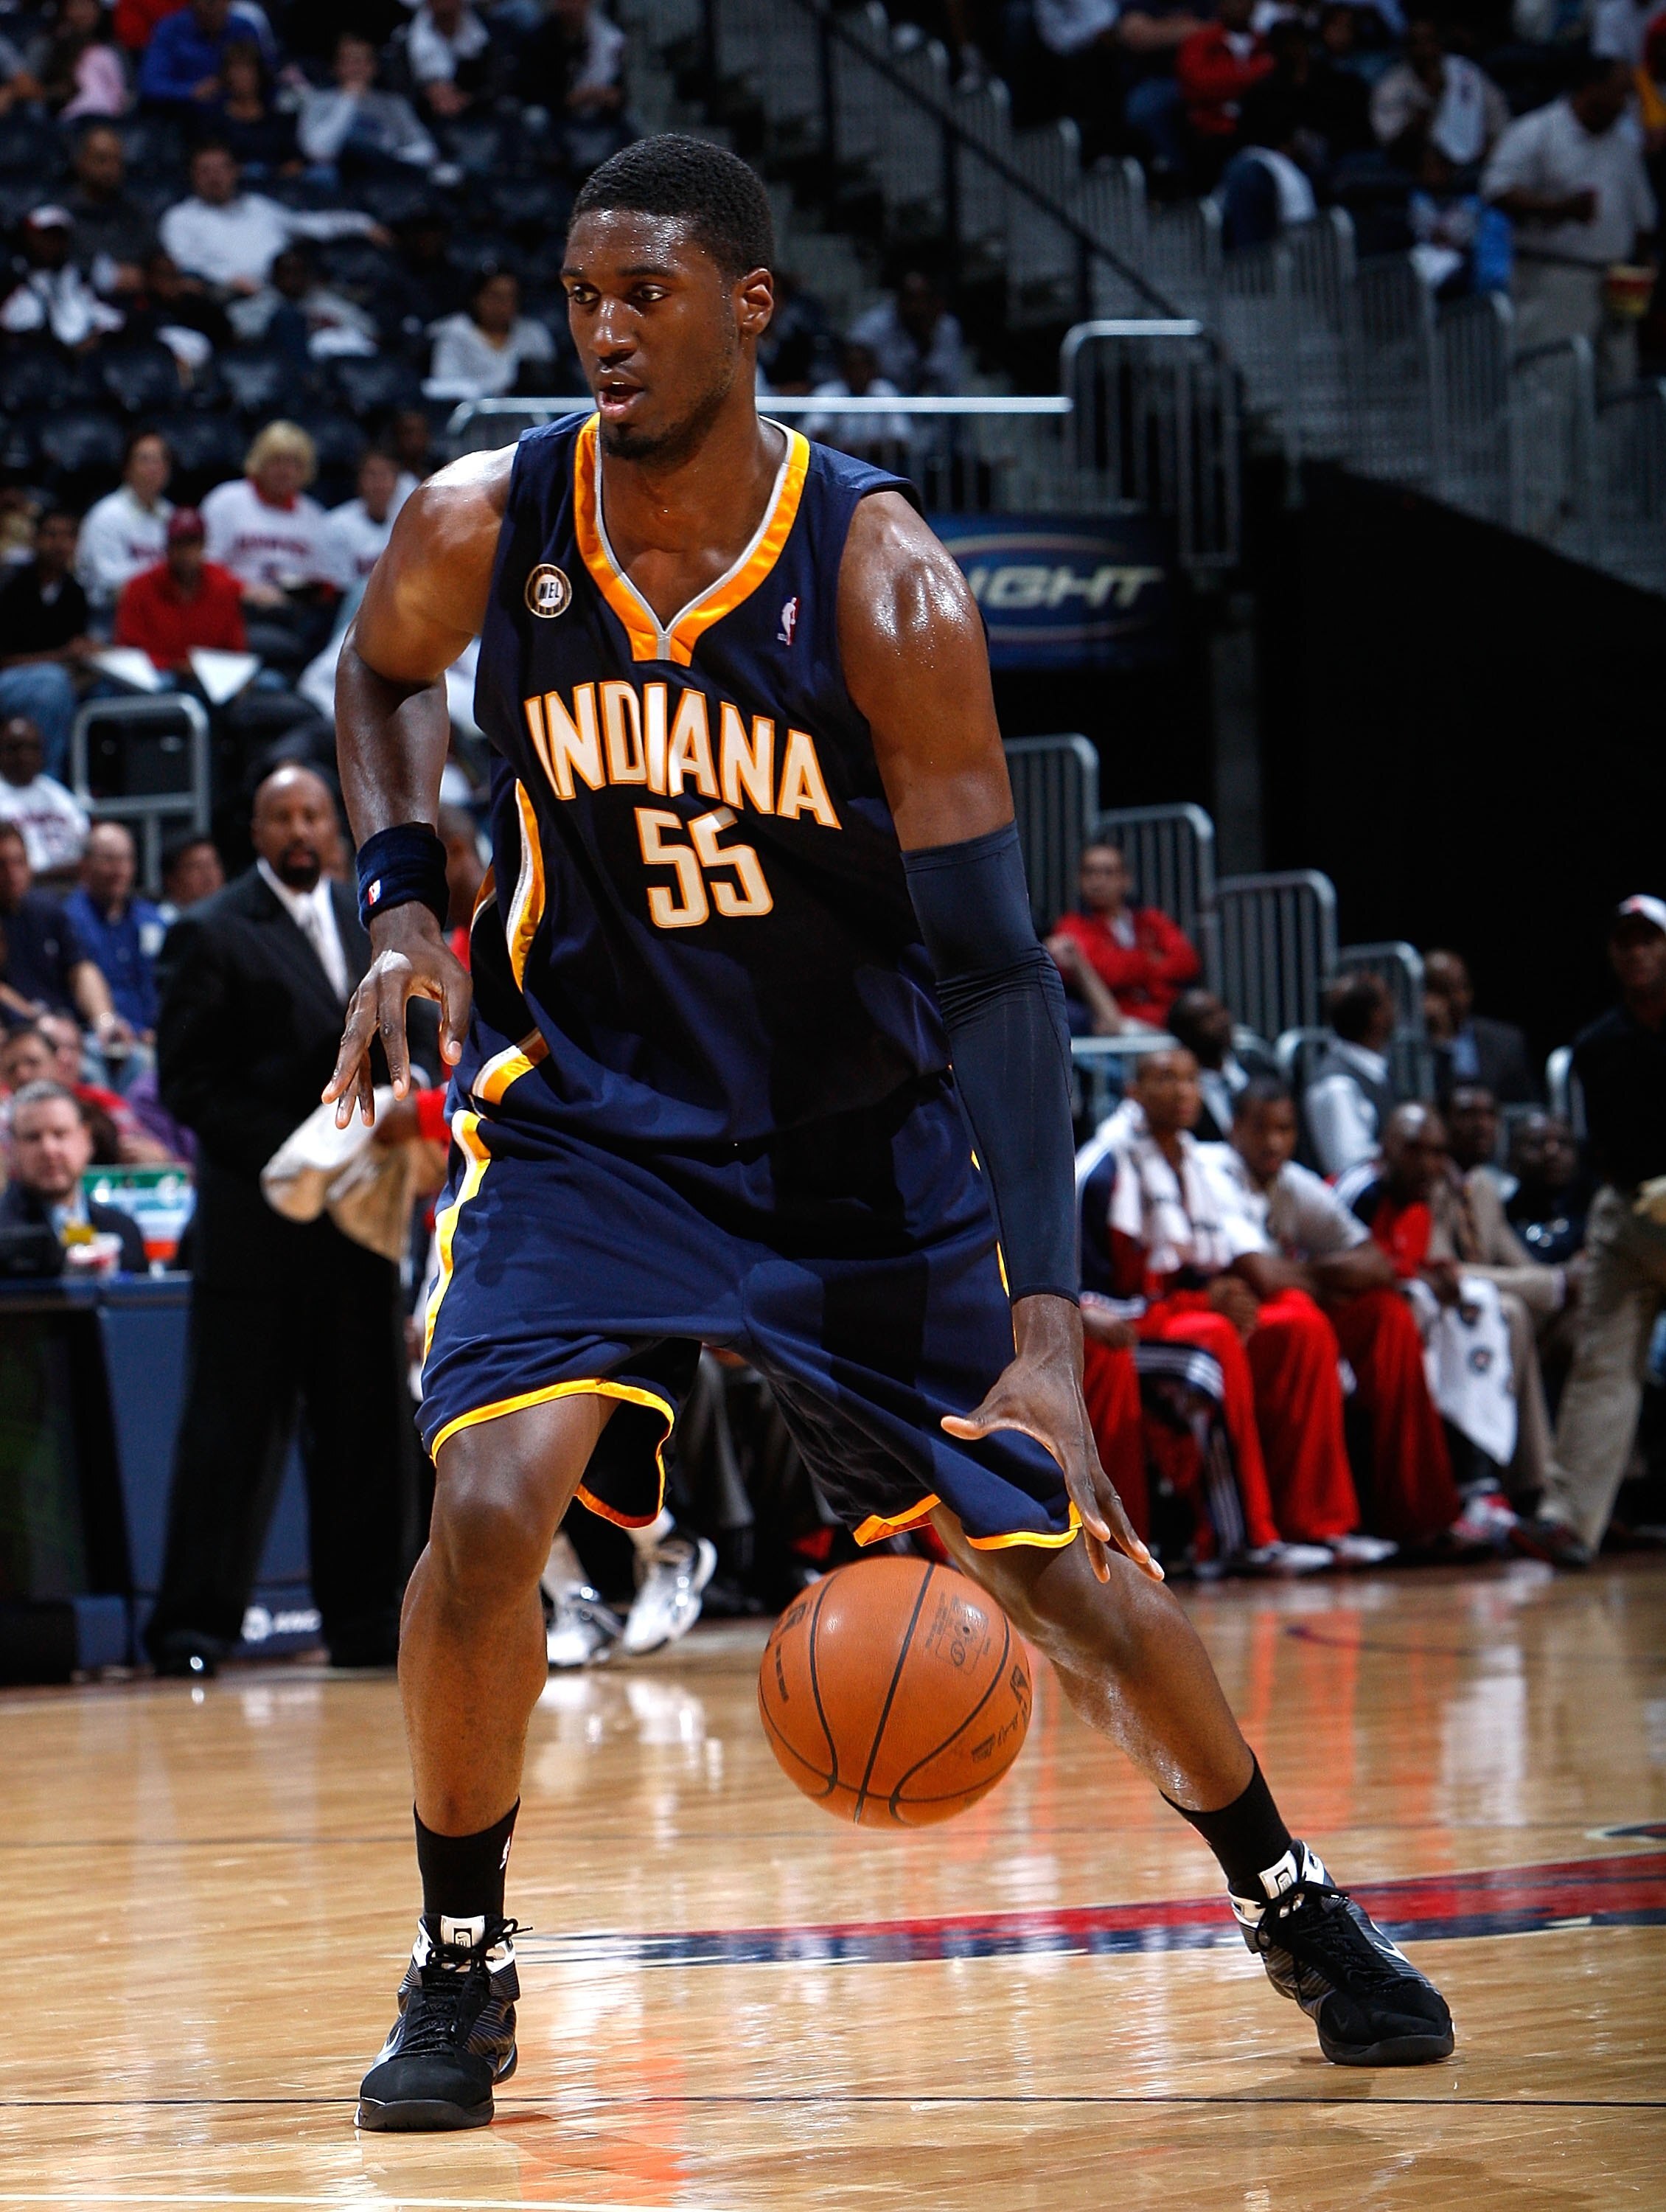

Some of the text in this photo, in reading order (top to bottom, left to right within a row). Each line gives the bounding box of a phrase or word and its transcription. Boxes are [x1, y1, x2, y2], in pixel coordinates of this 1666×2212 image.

[968, 565, 1164, 608] IGHT
[524, 680, 842, 830] INDIANA
[633, 806, 774, 928] 55
